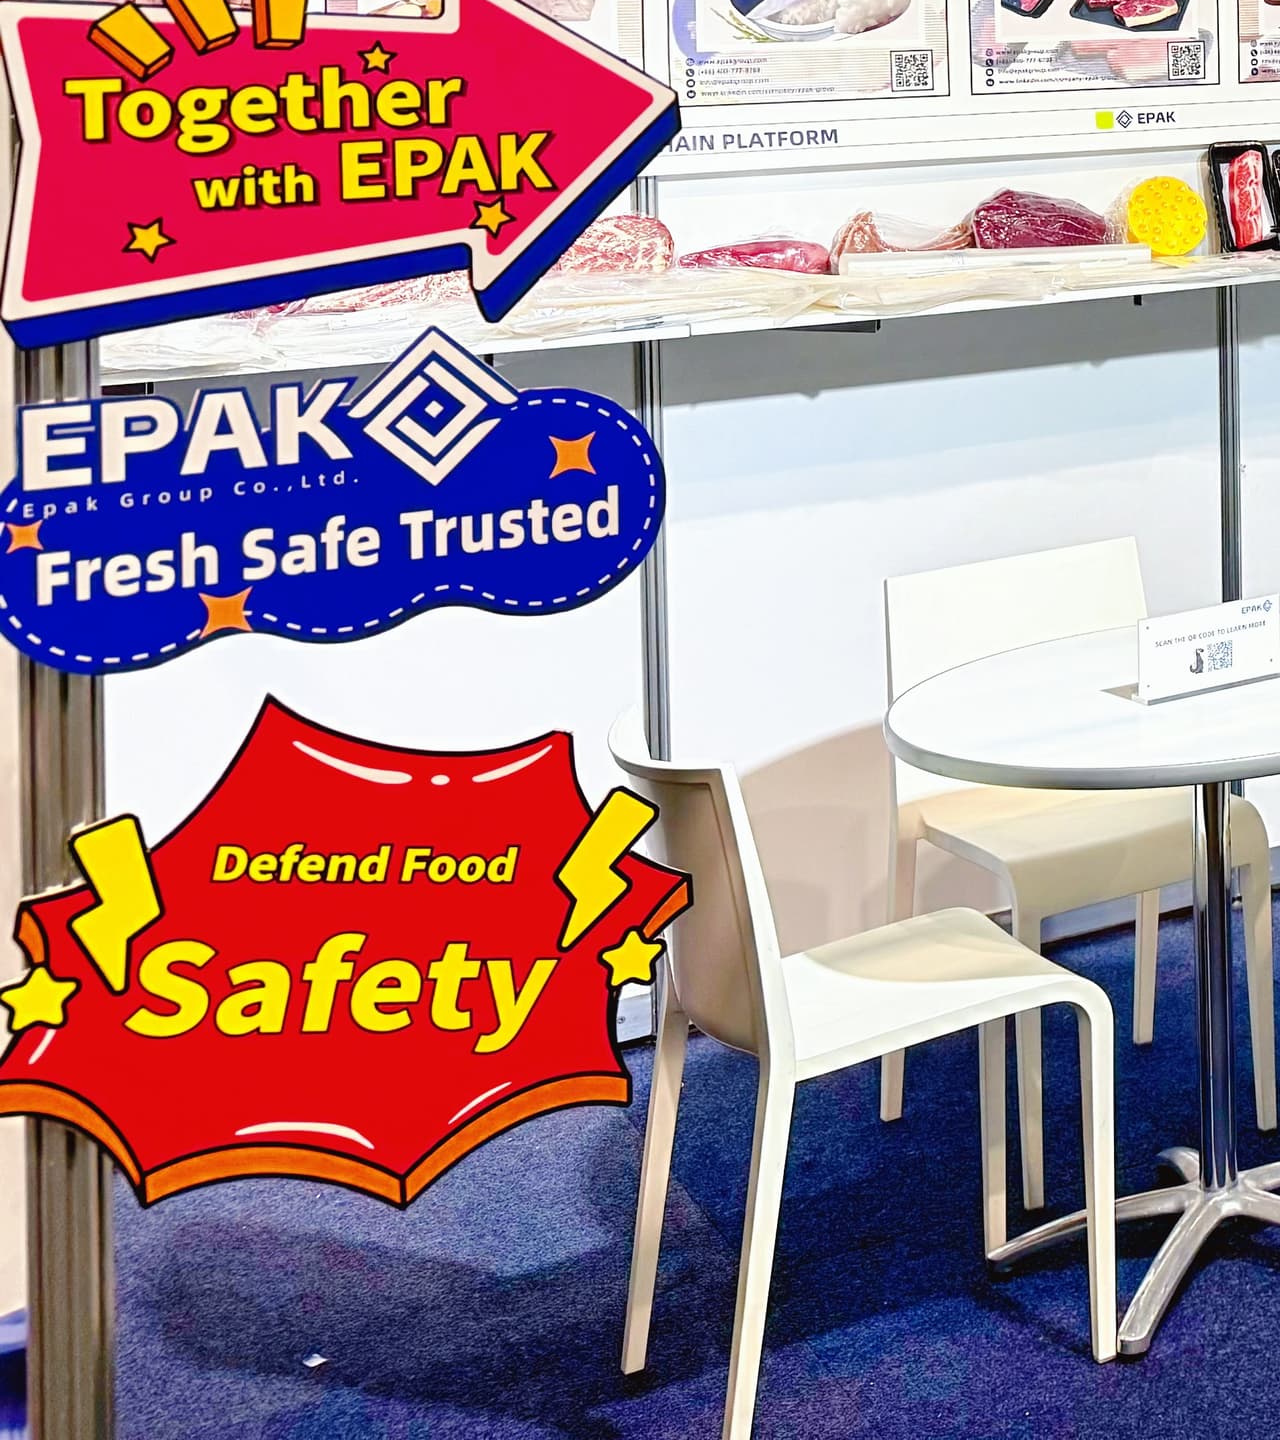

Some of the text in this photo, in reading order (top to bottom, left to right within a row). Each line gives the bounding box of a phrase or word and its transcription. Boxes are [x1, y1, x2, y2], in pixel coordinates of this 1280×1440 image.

[63, 66, 464, 154] Together
[194, 131, 555, 209] with EPAK
[21, 377, 355, 492] EPAK
[22, 471, 359, 520] Epak Group Co.,Ltd.
[35, 486, 619, 607] Fresh Safe Trusted
[211, 843, 519, 884] Defend Food
[124, 933, 561, 1054] Safety
